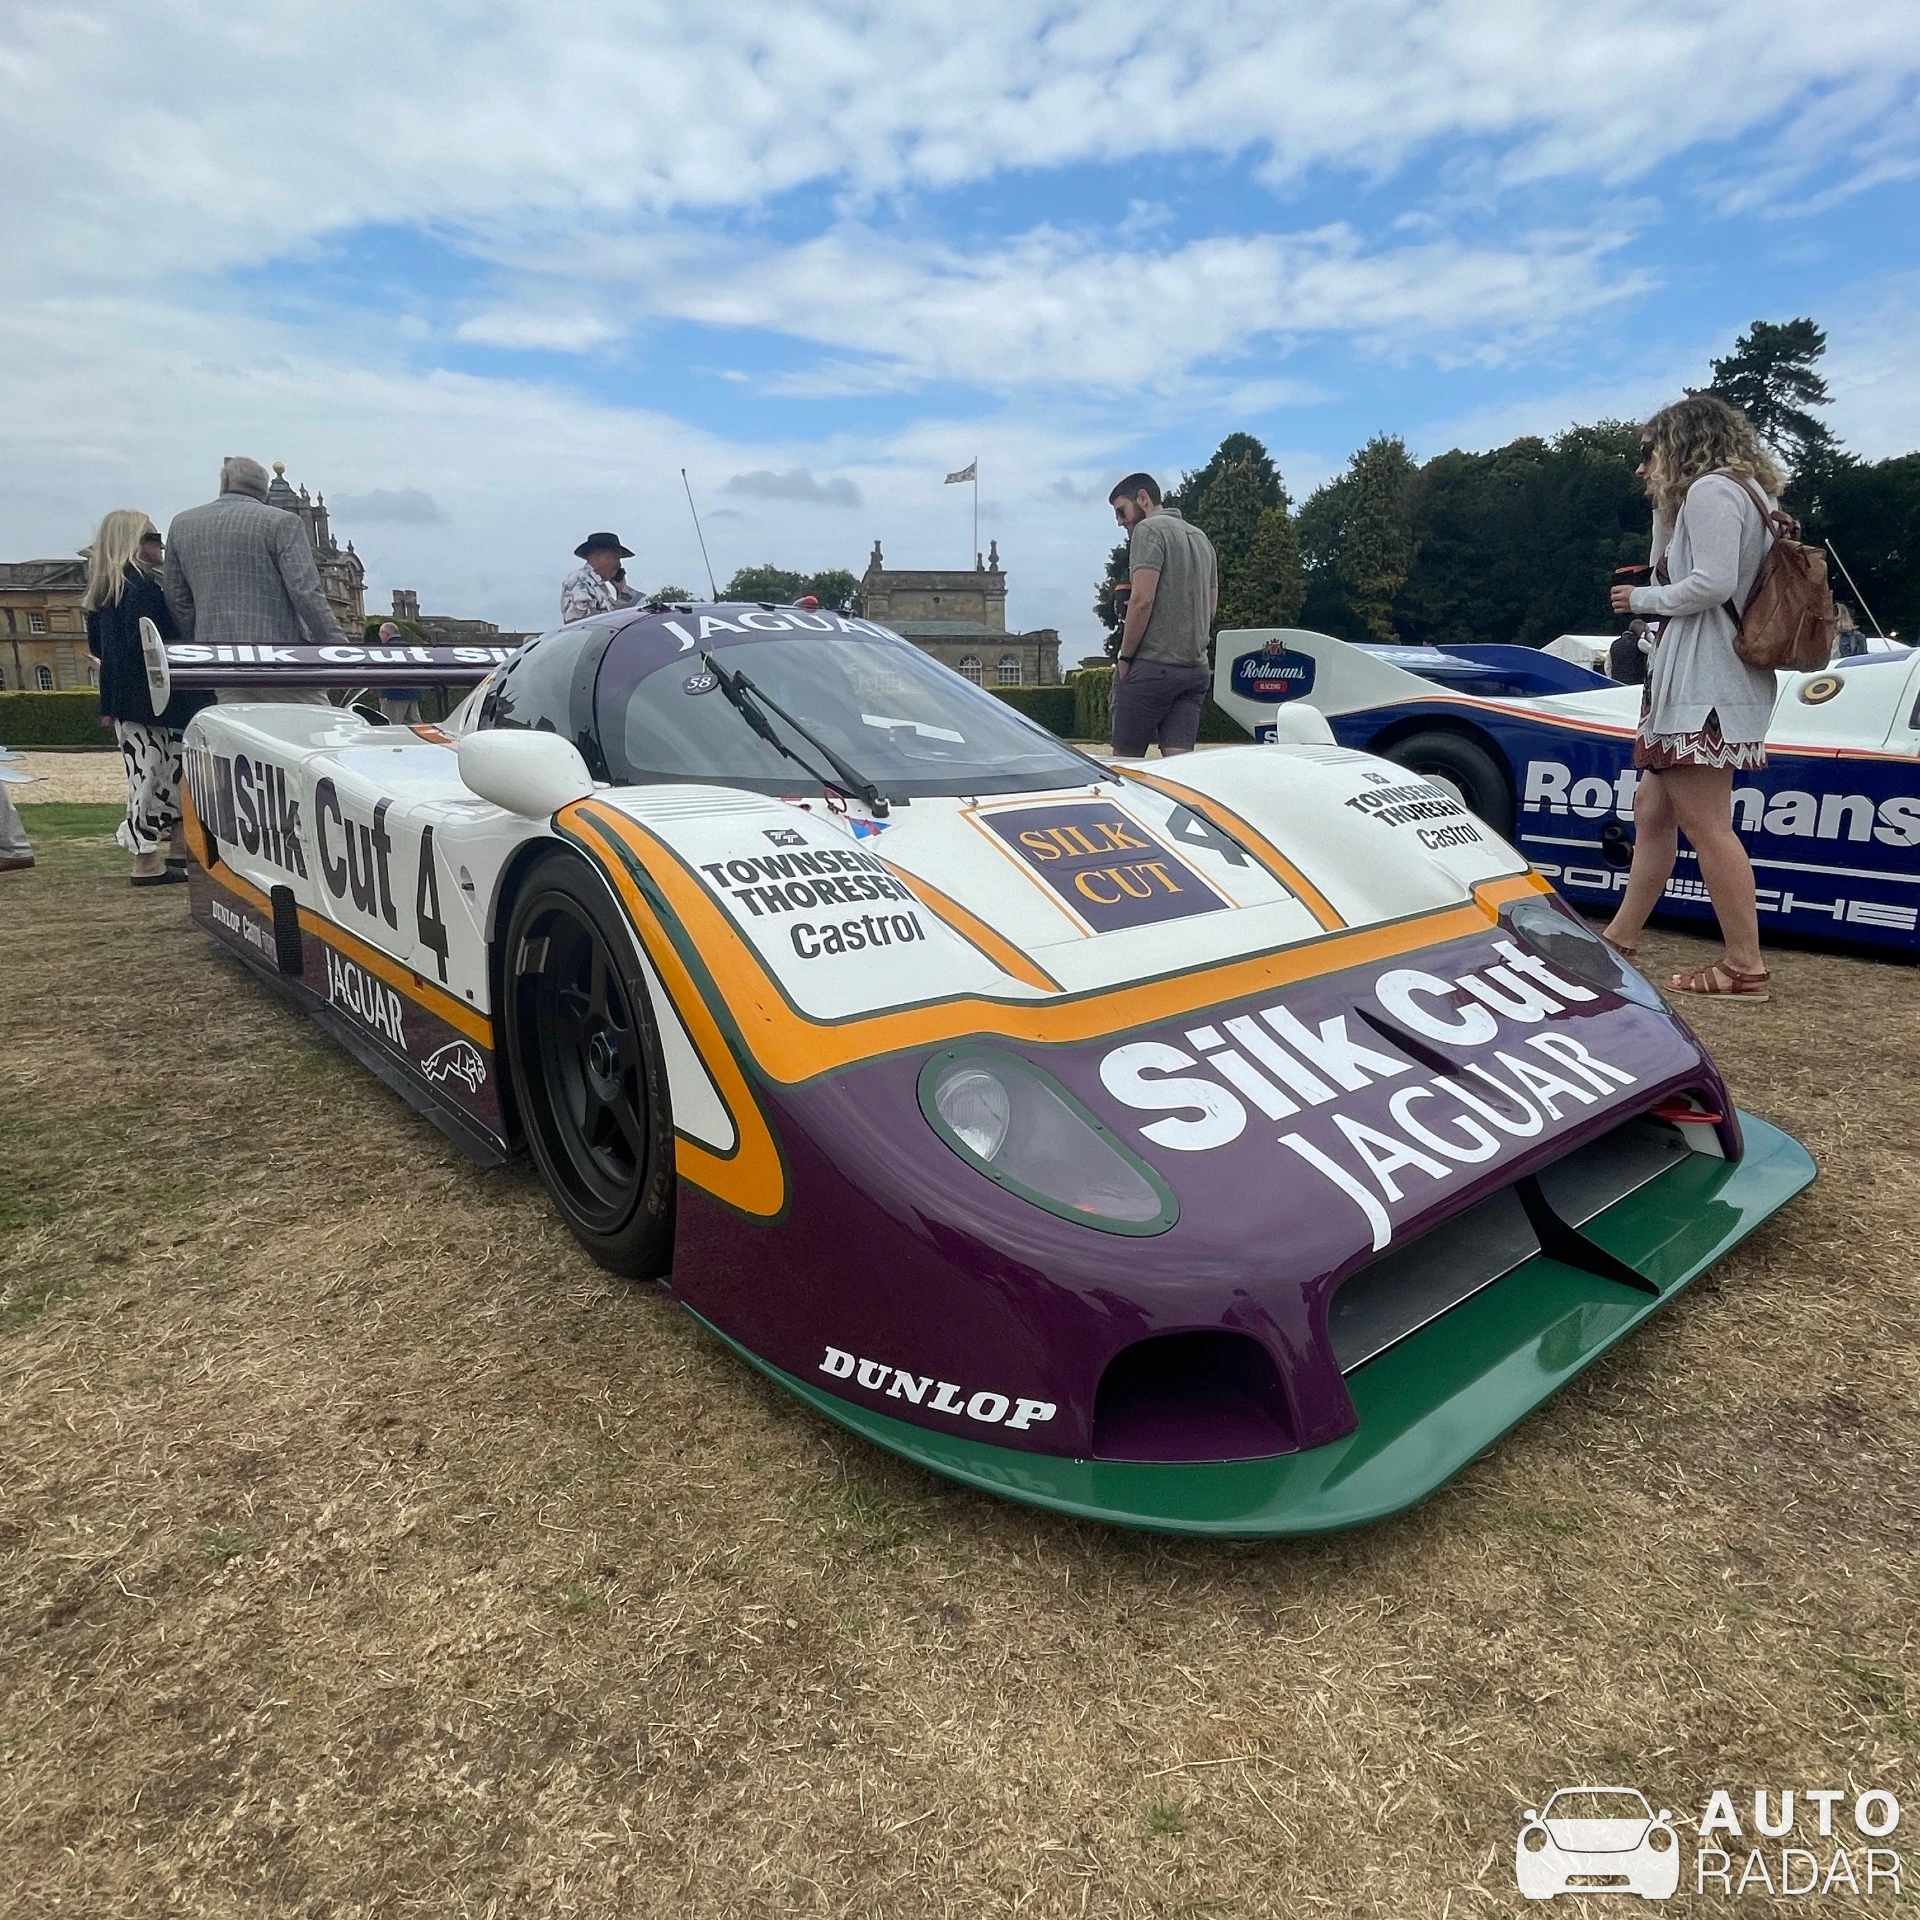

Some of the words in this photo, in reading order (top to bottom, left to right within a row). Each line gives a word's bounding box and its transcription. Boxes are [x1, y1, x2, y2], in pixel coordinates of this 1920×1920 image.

[167, 645, 301, 662] Silk
[318, 646, 435, 662] Cut
[452, 647, 517, 662] Si
[1240, 659, 1306, 679] Rothmans
[687, 677, 711, 689] 58
[1344, 784, 1446, 814] TOWNSEND
[1372, 800, 1466, 827] THORESEN
[235, 754, 308, 880] Silk
[315, 777, 397, 931] Cut
[1018, 822, 1151, 862] SILK
[1165, 803, 1251, 868] 4
[1416, 822, 1483, 850] Castrol
[417, 825, 449, 984] 4
[1074, 862, 1184, 905] CUT
[790, 911, 926, 959] Castrol
[325, 946, 408, 1051] JAGUAR
[1099, 1005, 1414, 1151] Silk
[1375, 940, 1599, 1046] Cut
[1277, 1031, 1638, 1253] JAGUAR
[818, 1346, 1057, 1430] DUNLOP
